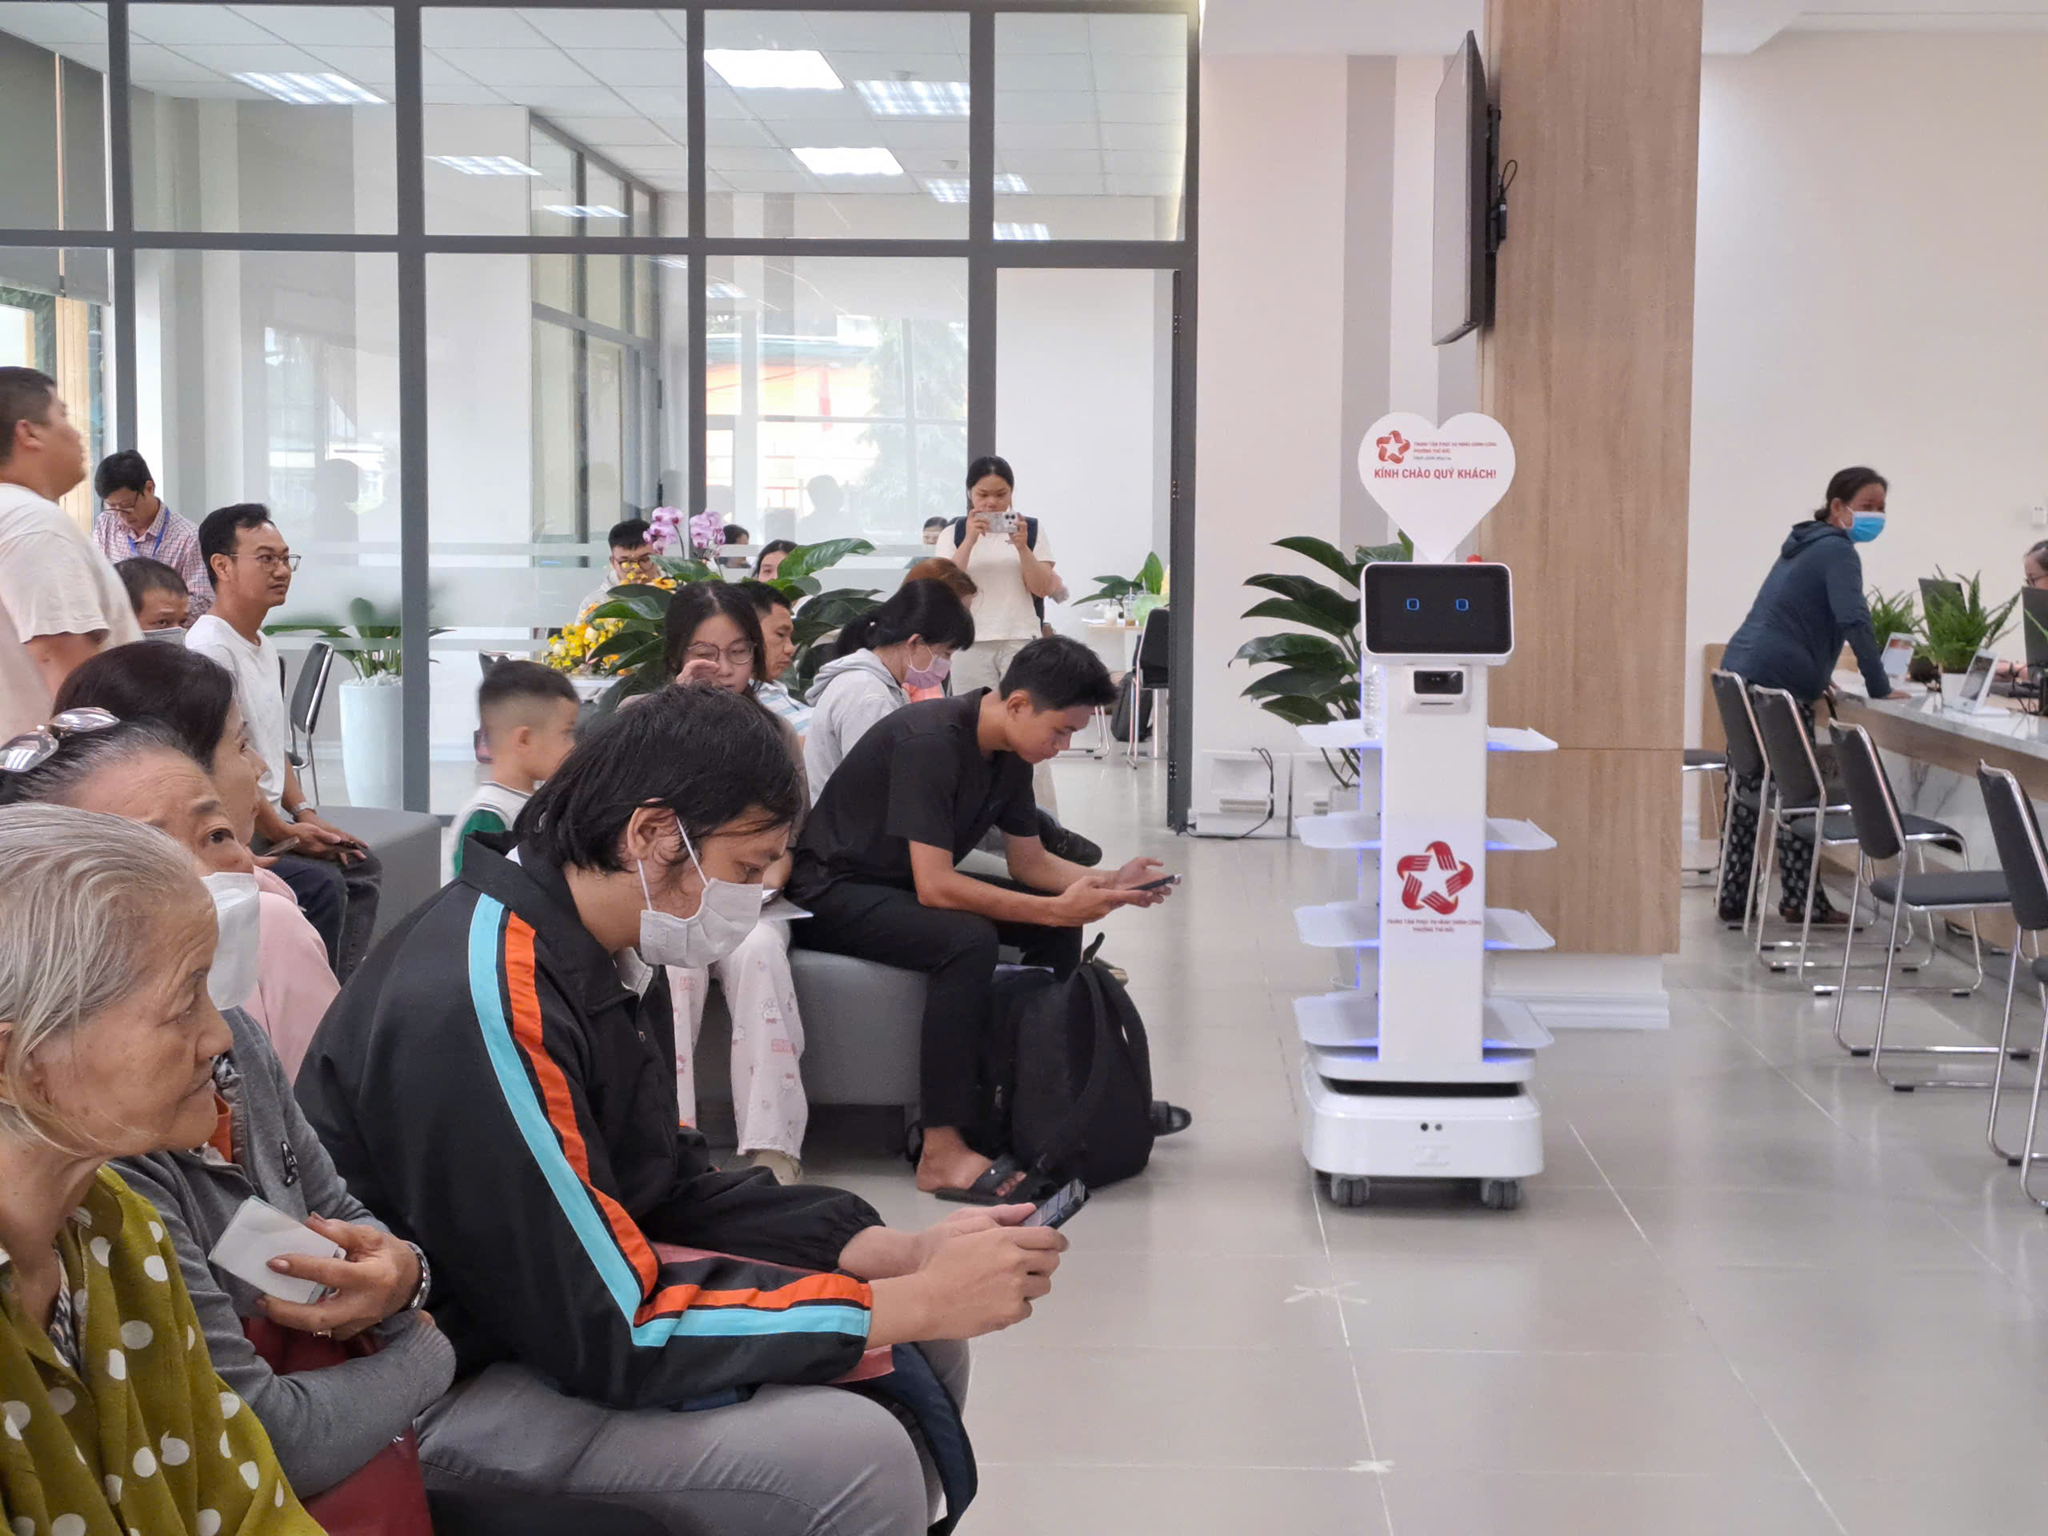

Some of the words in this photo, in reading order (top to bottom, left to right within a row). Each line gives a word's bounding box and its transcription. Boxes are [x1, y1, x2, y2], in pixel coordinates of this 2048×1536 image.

[1374, 466, 1399, 479] KÍNH
[1402, 466, 1431, 479] CHÀO
[1457, 466, 1497, 479] KHÁCH!
